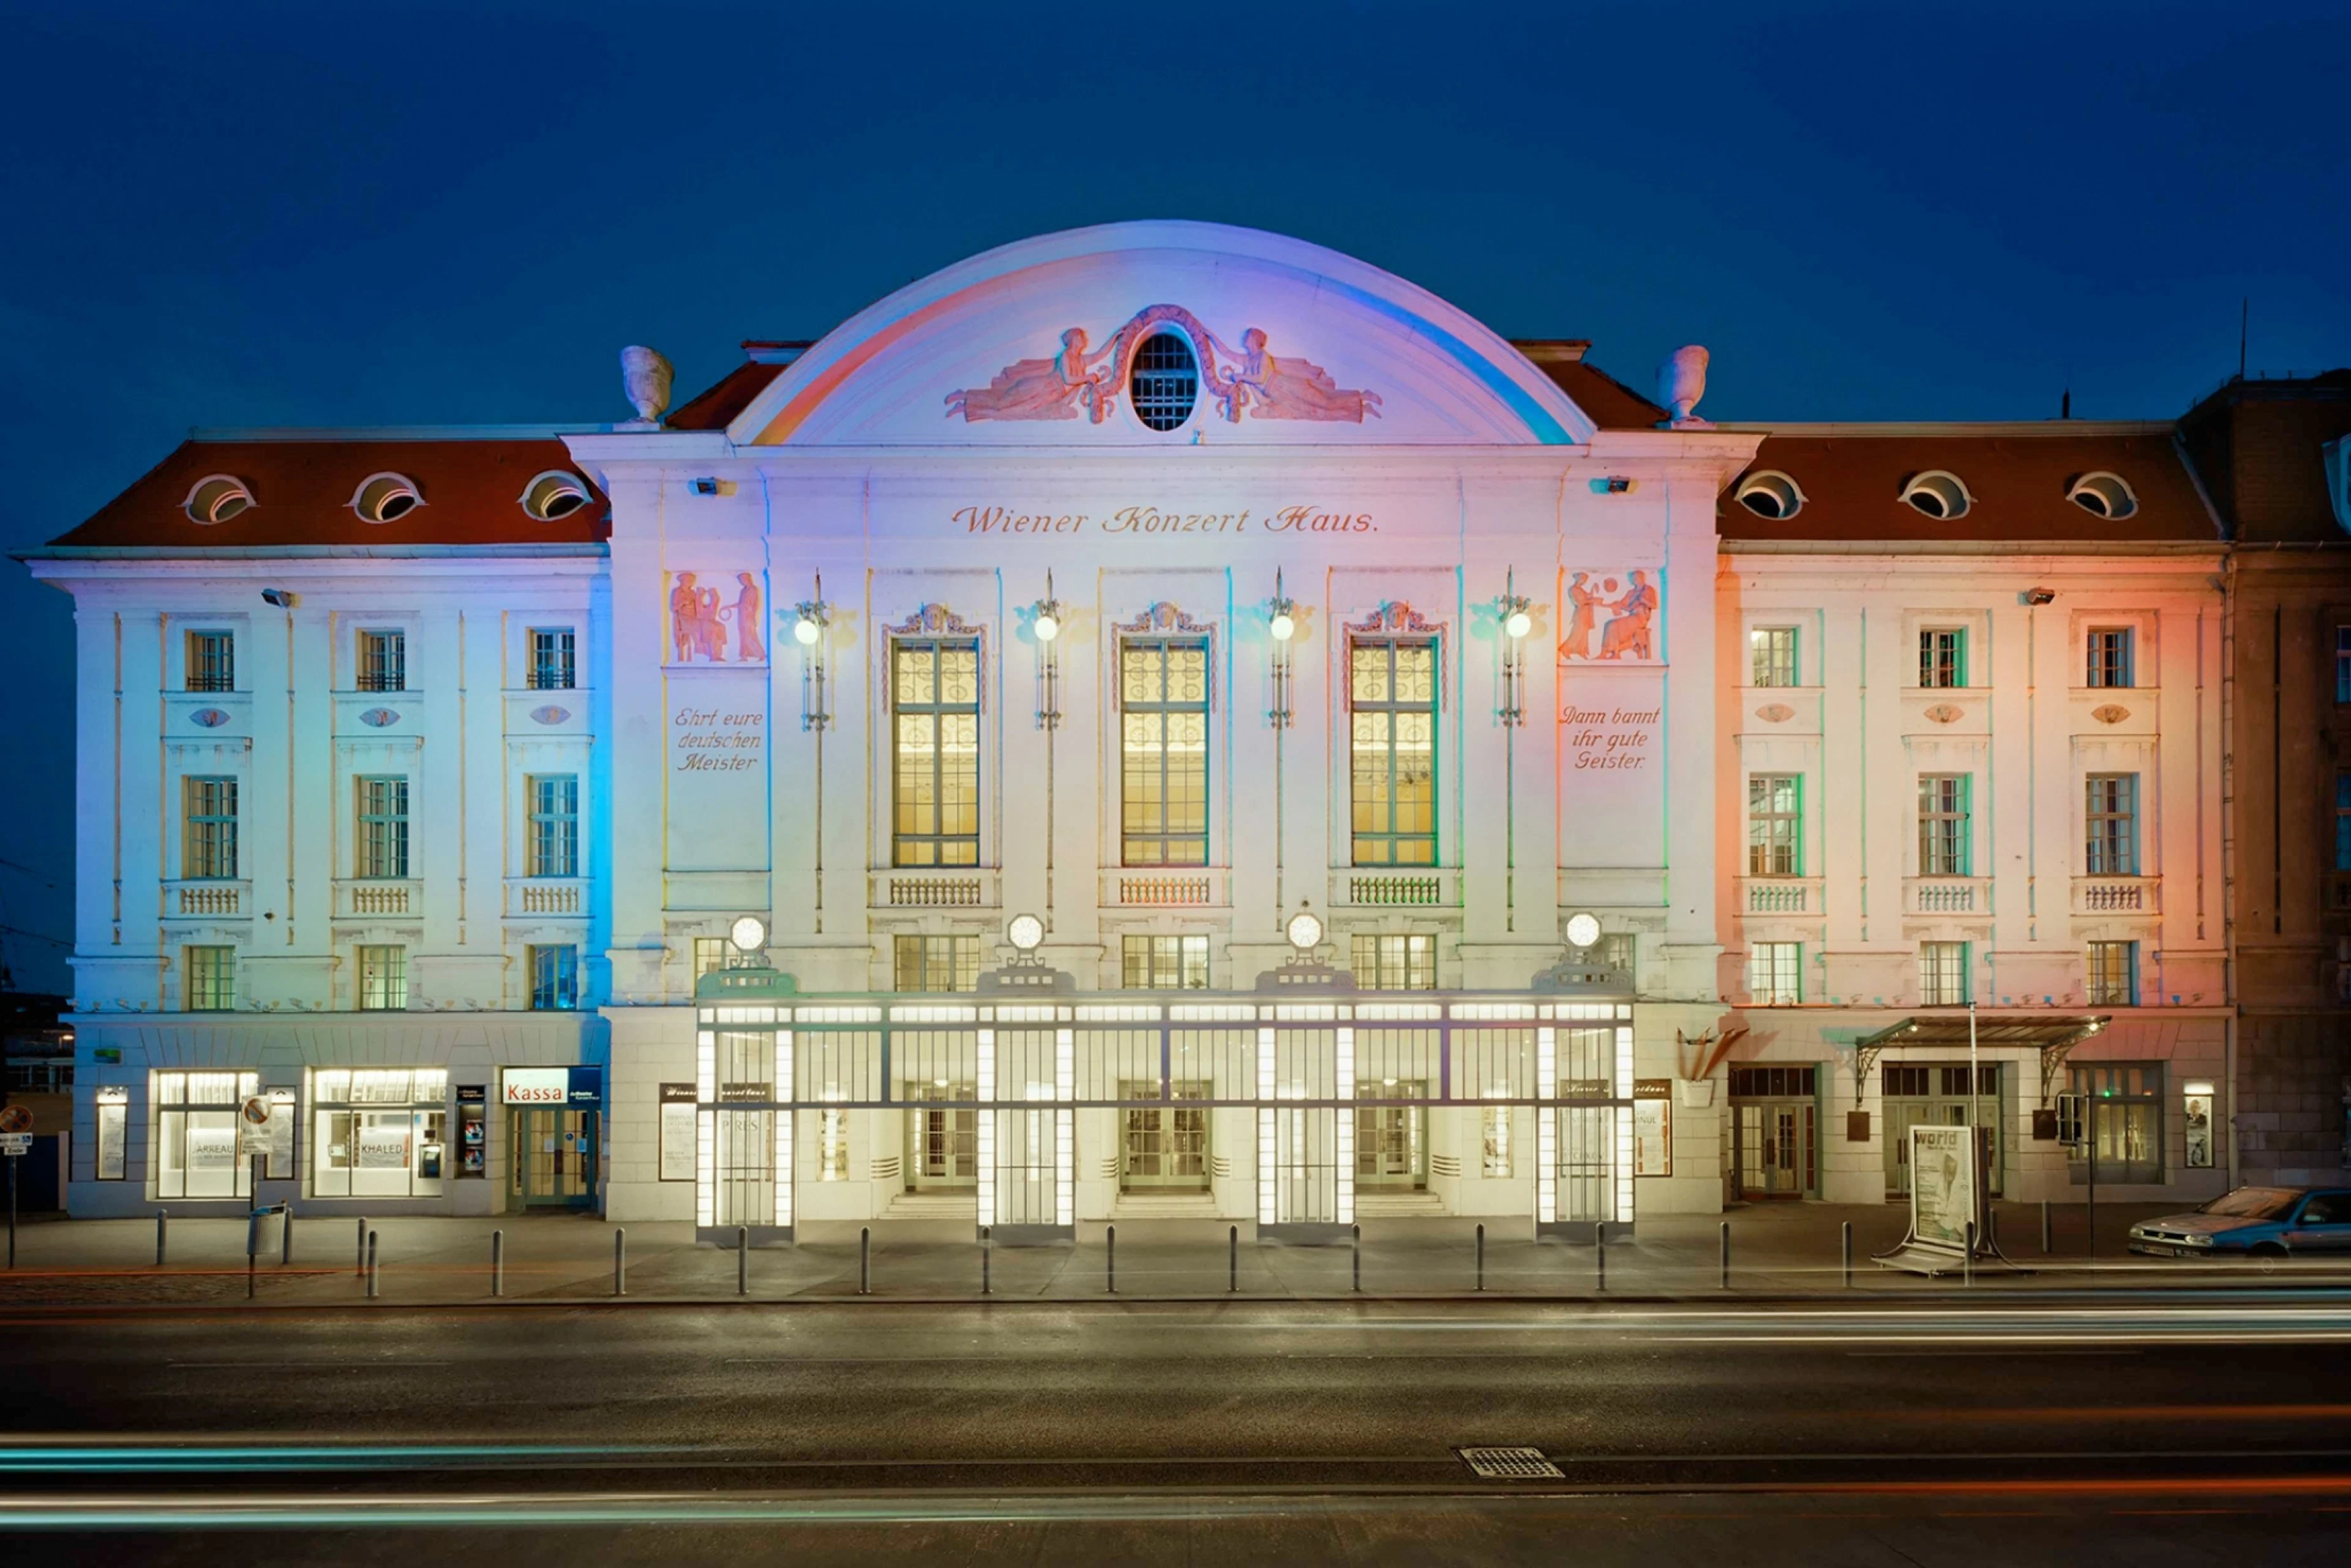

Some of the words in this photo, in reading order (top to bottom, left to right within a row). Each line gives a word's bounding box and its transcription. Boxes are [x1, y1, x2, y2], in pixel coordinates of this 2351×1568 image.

[951, 506, 1089, 533] Wiener
[1101, 506, 1250, 533] Konzert
[1264, 505, 1379, 533] Haus.
[675, 708, 719, 726] Ehrt
[723, 713, 763, 726] eure
[1558, 705, 1606, 725] Dann
[1611, 707, 1661, 725] bannt
[678, 731, 761, 749] deutschen
[1572, 729, 1603, 747] ihr
[1607, 730, 1648, 752] gute
[677, 752, 758, 771] Meister
[1575, 751, 1646, 769] Geister.
[508, 1084, 562, 1100] Kassa
[1914, 1131, 1957, 1145] world
[361, 1144, 403, 1154] KHALED
